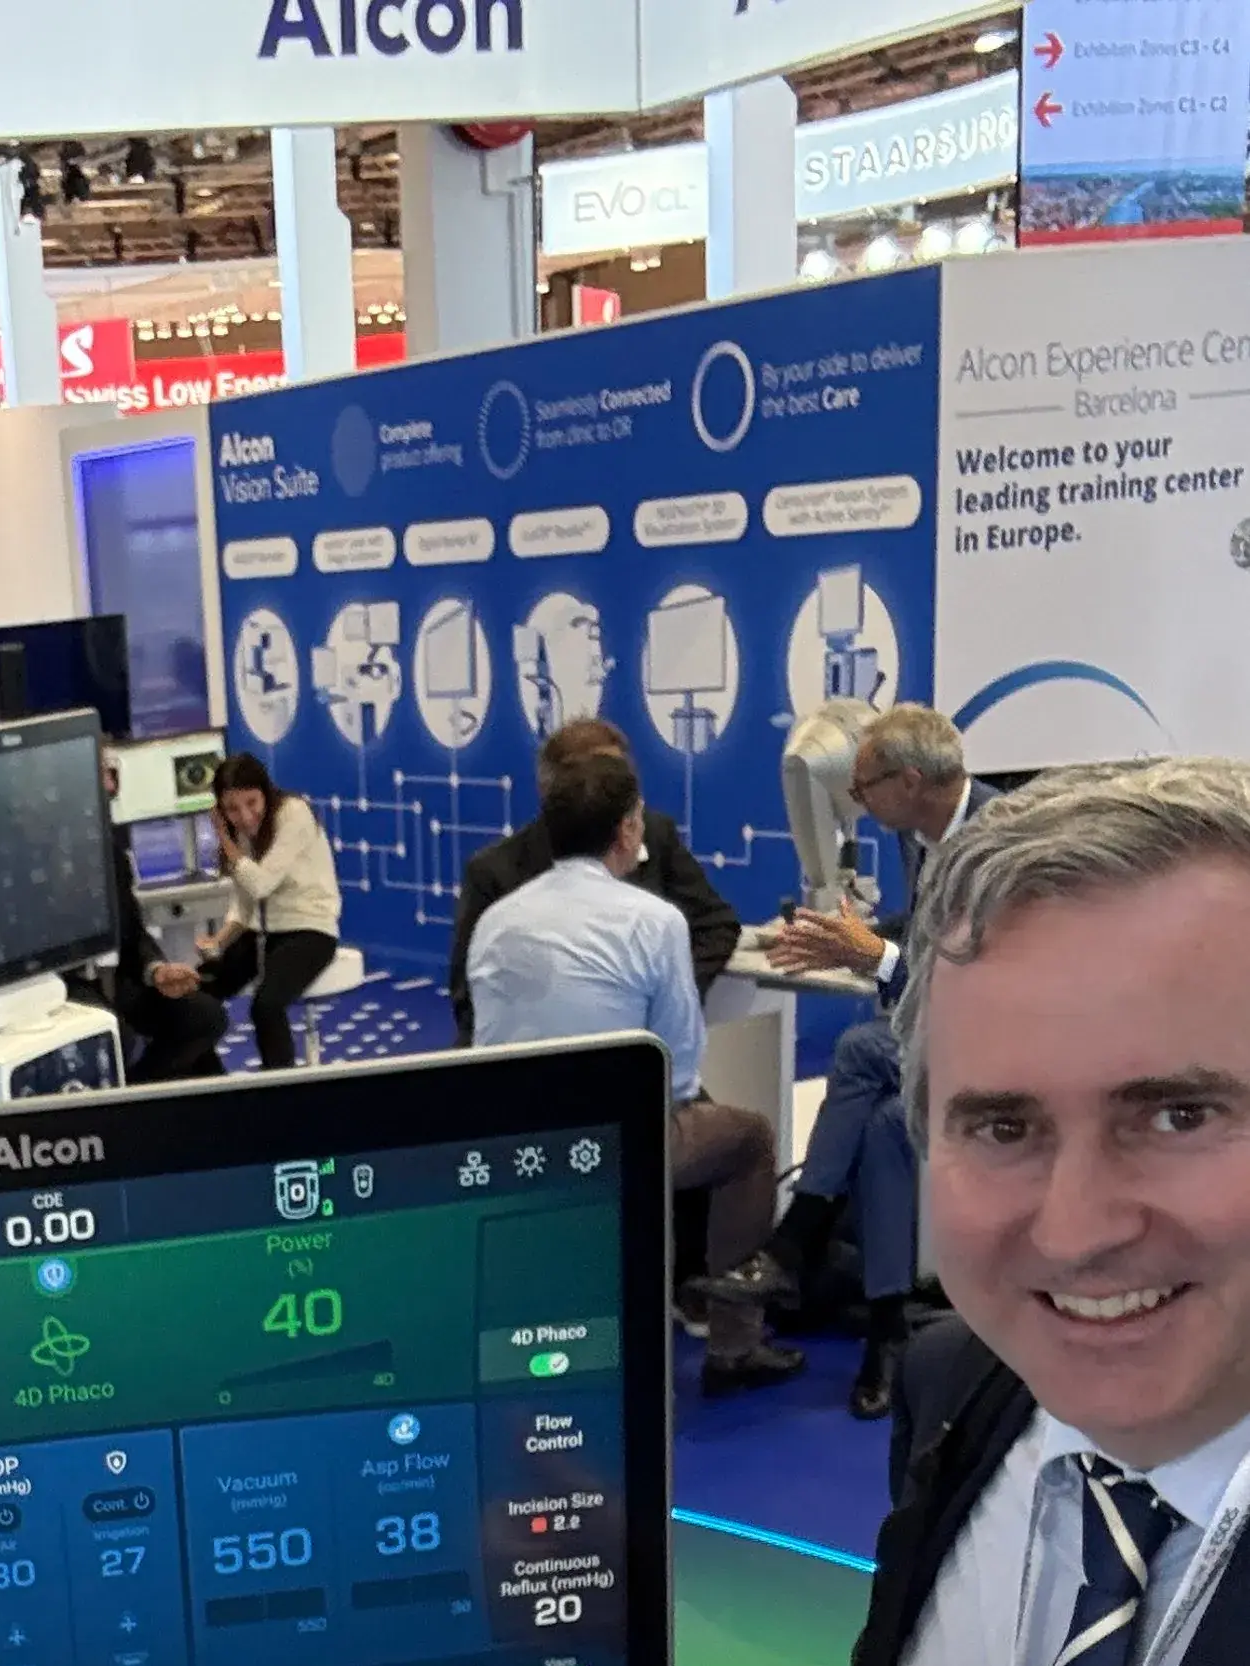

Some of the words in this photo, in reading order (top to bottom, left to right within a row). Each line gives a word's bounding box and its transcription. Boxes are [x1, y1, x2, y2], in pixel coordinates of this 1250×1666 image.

[258, 0, 524, 58] Alcon
[574, 181, 645, 223] EVO
[955, 347, 1037, 383] Alcon
[1046, 337, 1194, 382] Experience
[154, 376, 212, 407] Low
[1074, 384, 1177, 418] Barcelona
[219, 431, 275, 468] Alcon
[956, 445, 1075, 476] Welcome
[1083, 441, 1108, 464] to
[1115, 436, 1173, 468] your
[220, 471, 272, 504] Vision
[273, 464, 320, 500] Suite
[956, 482, 1051, 515] leading
[1058, 472, 1158, 503] training
[1164, 465, 1244, 494] center
[955, 526, 979, 553] in
[986, 521, 1082, 552] Europe.
[32, 1192, 63, 1210] CDE
[6, 1208, 94, 1247] 0.00
[266, 1233, 332, 1254] Power
[263, 1288, 342, 1338] 40
[512, 1330, 532, 1346] 4D
[537, 1325, 587, 1343] Phaco
[14, 1386, 44, 1408] 4D
[49, 1381, 115, 1404] Phaco
[536, 1413, 572, 1432] Flow
[526, 1431, 583, 1452] Control
[361, 1458, 399, 1478] Asp
[403, 1453, 450, 1474] Flow
[217, 1471, 298, 1494] Vacuum
[508, 1496, 567, 1517] Incision
[571, 1491, 603, 1509] Size
[375, 1512, 441, 1556] 38
[101, 1546, 146, 1578] 27
[213, 1527, 312, 1574] 550
[515, 1554, 600, 1577] Continuous
[501, 1577, 547, 1598] Reflux
[552, 1569, 614, 1595] (mmHg)
[535, 1595, 582, 1627] 20
